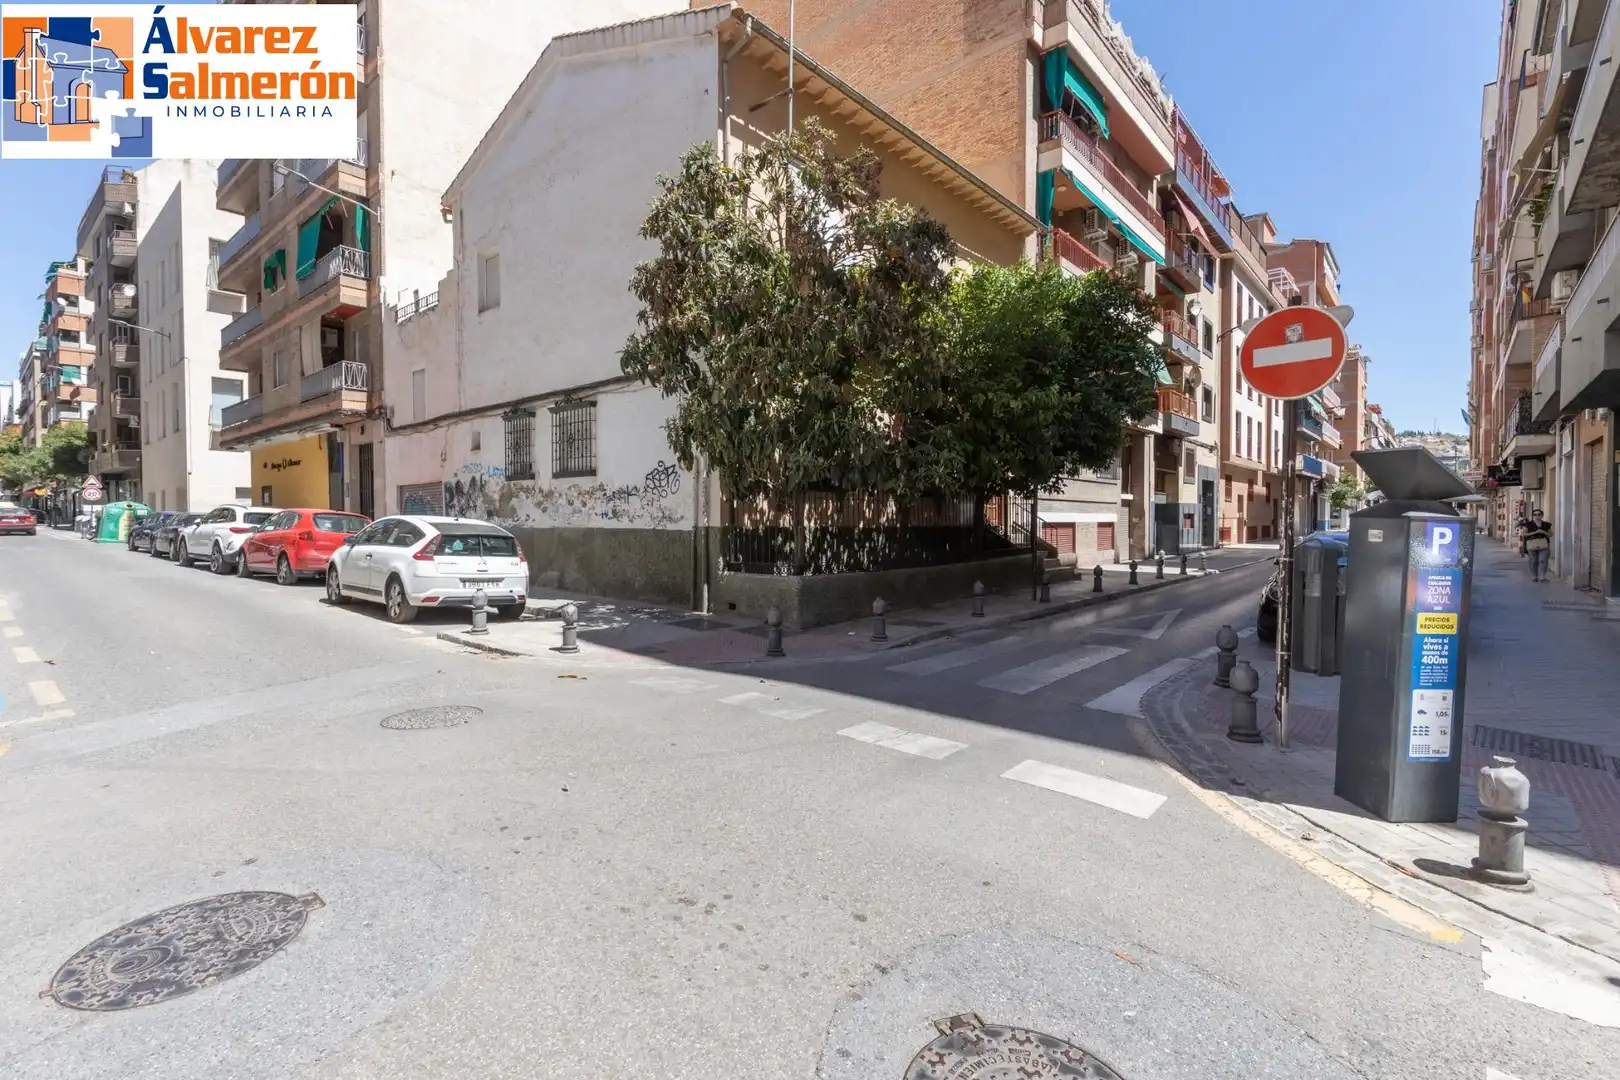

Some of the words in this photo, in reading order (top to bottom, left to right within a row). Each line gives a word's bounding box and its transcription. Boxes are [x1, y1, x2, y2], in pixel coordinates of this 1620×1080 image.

[1431, 527, 1453, 556] P
[1428, 586, 1451, 594] ZONA
[1427, 595, 1450, 603] AZUL
[1422, 656, 1448, 664] 400m
